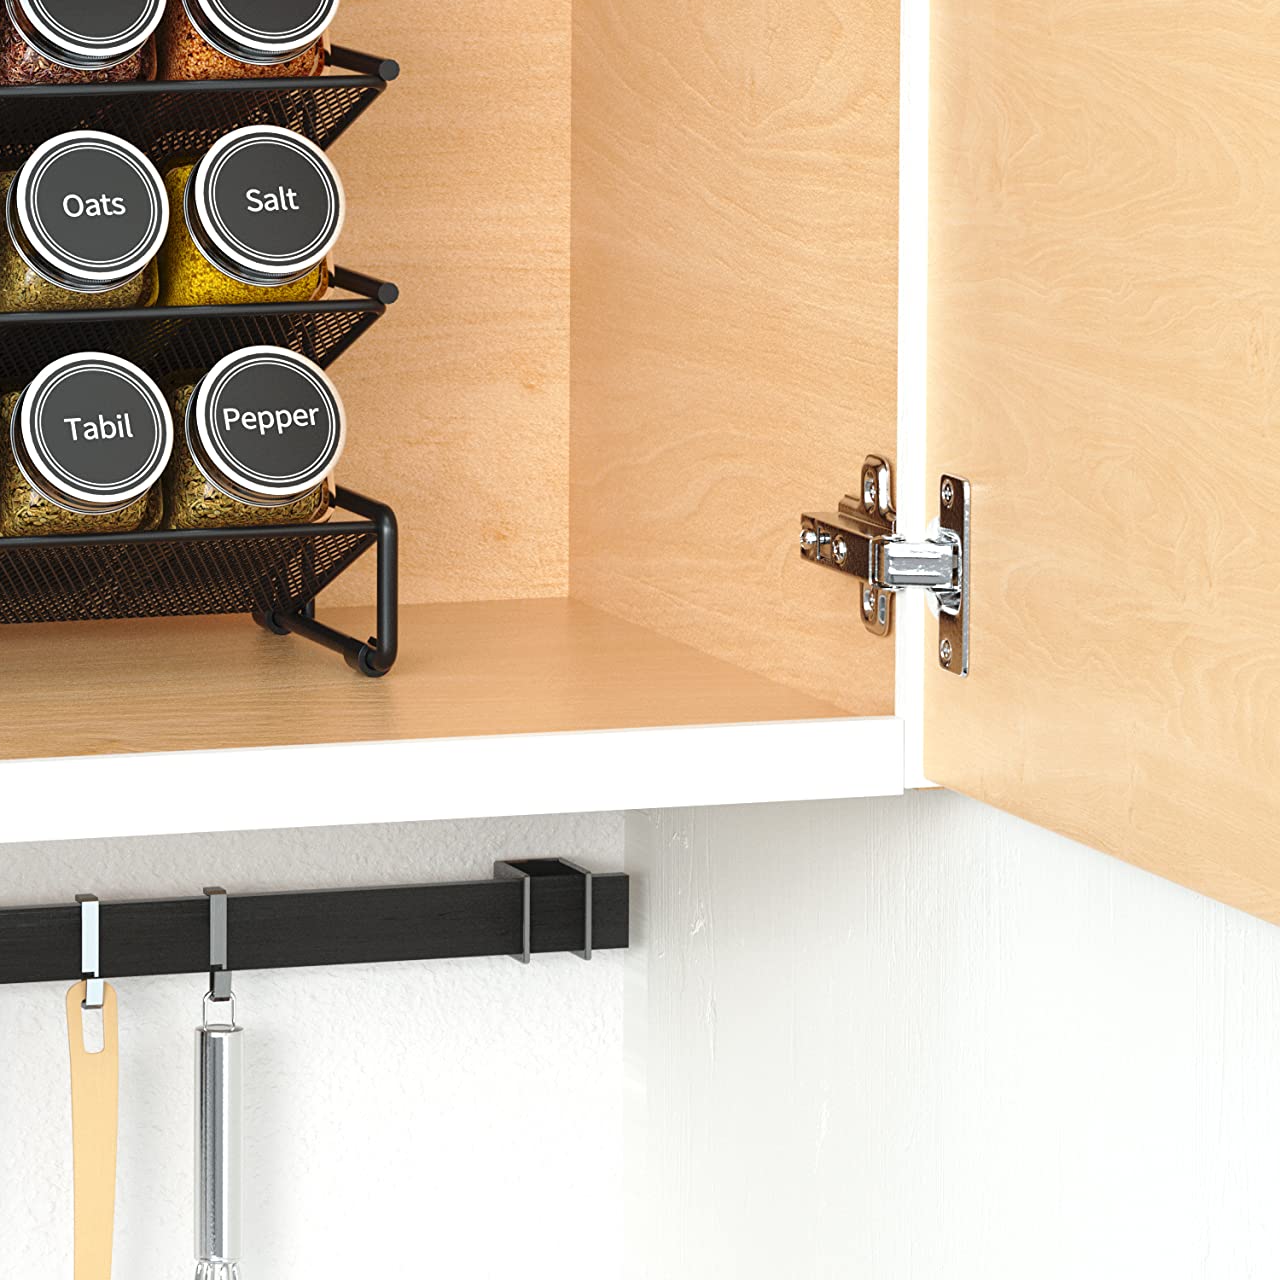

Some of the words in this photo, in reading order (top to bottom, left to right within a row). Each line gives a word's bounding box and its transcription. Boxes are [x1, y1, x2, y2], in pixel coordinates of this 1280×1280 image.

[62, 193, 127, 218] Oats
[245, 185, 300, 213] Salt
[63, 412, 134, 441] Tabil
[222, 407, 320, 436] Pepper
